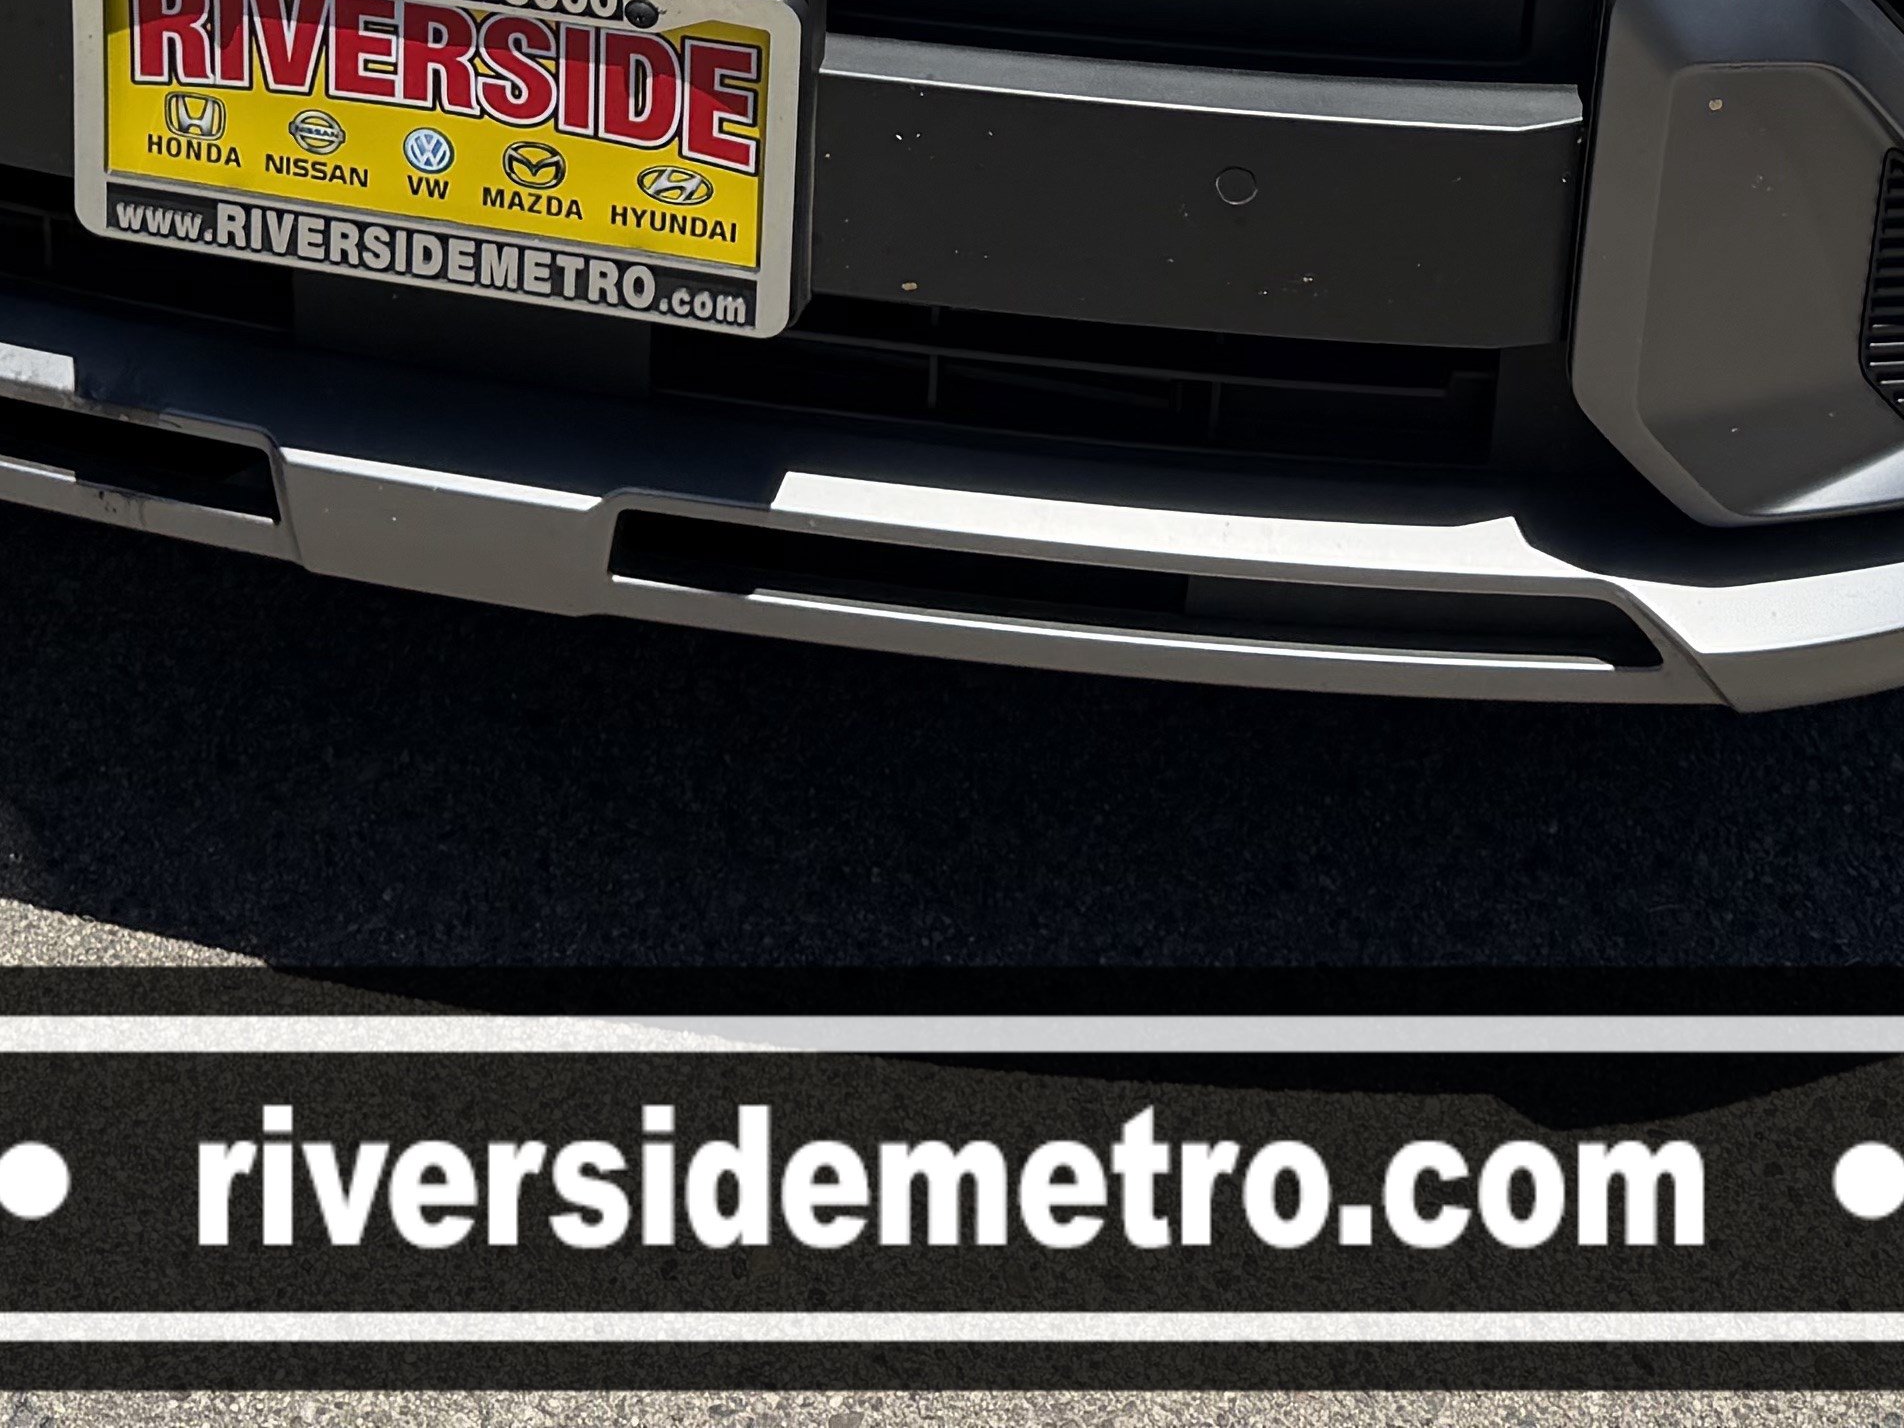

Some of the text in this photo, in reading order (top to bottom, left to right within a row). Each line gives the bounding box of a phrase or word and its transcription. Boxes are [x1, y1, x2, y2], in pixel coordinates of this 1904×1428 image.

[147, 133, 241, 168] HONDA
[265, 153, 368, 187] NISSAN
[406, 174, 449, 200] VW
[482, 186, 584, 221] MAZDA
[610, 204, 737, 244] HYUNDAI
[115, 202, 747, 325] www.RIVERSIDEMETRO.com
